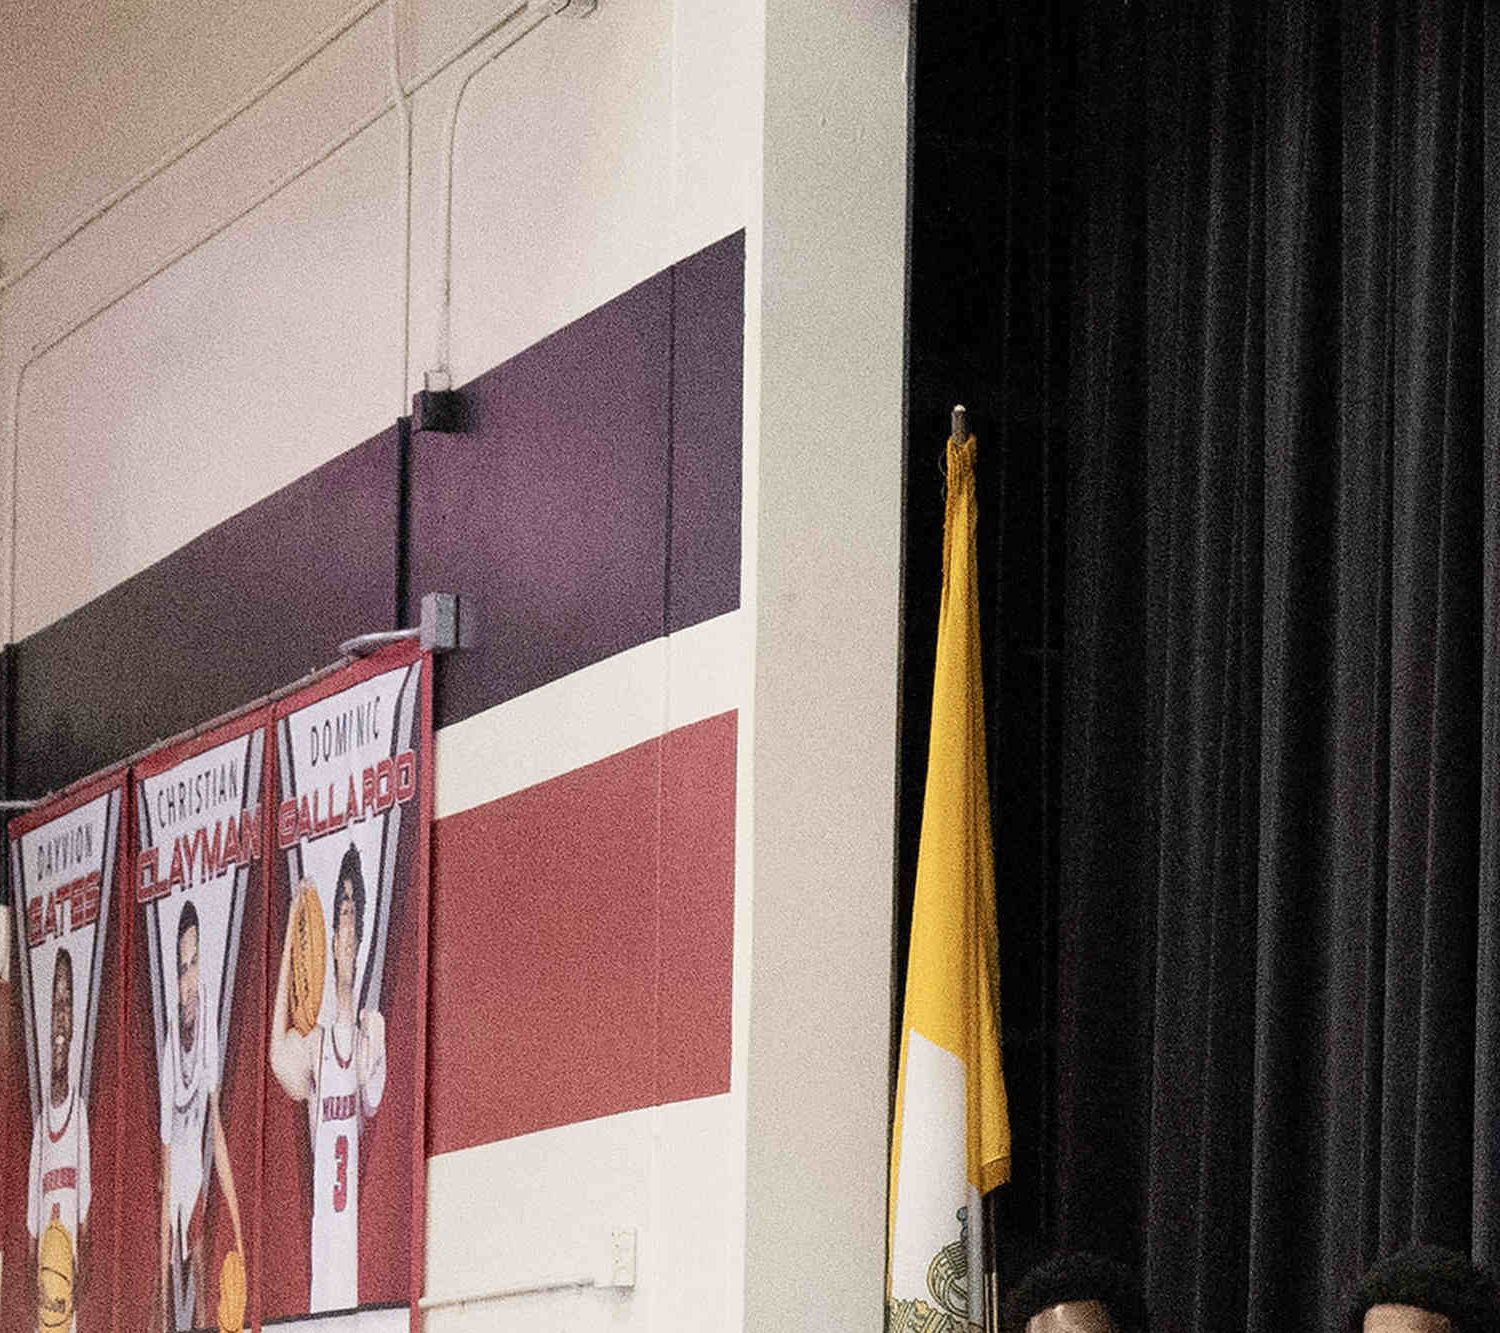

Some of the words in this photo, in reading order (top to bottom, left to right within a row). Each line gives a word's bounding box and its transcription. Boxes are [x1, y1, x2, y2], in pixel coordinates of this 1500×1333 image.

[310, 695, 382, 768] DOMINIC
[156, 759, 240, 830] CHRISTIAN
[278, 748, 419, 851] GALLARDO
[136, 807, 265, 904] CLAYMAN
[26, 871, 101, 948] GATES
